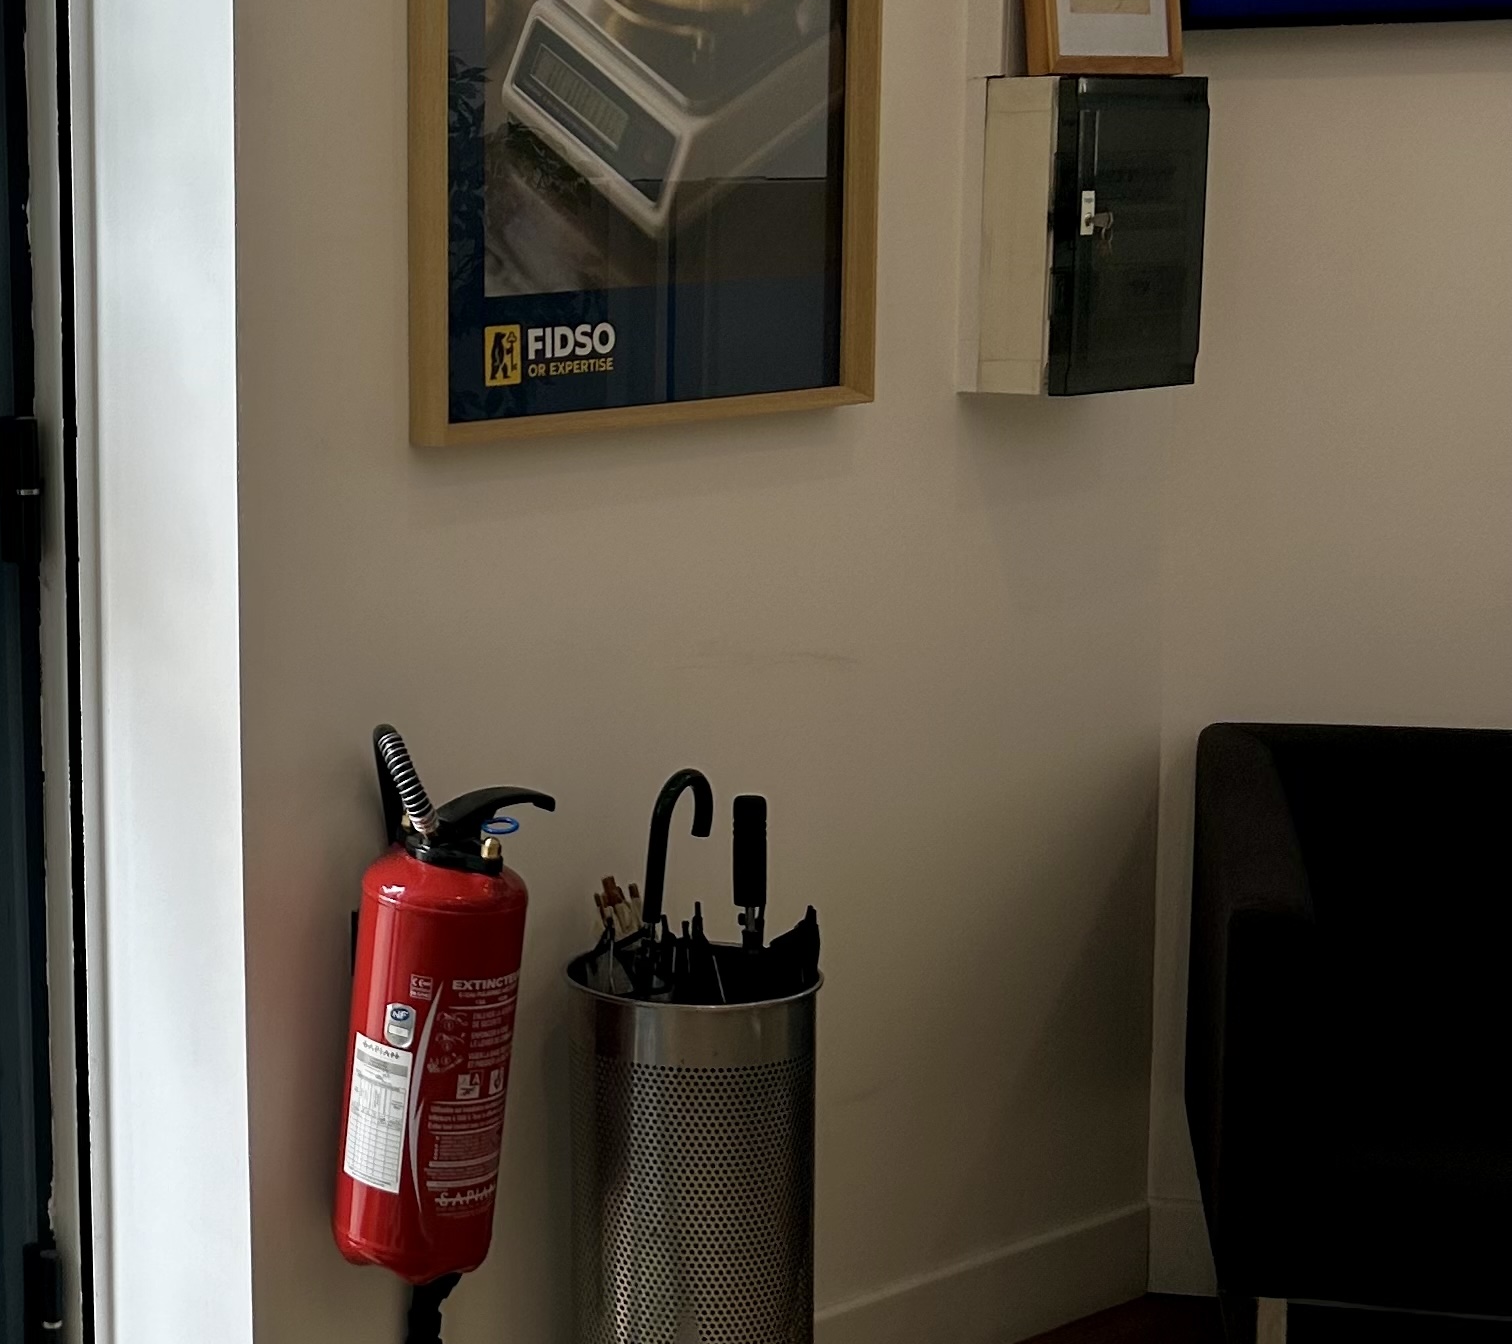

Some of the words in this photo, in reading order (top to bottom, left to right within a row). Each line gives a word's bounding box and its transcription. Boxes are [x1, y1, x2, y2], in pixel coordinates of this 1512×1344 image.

[527, 322, 616, 360] FIDSO
[528, 363, 546, 377] OR
[550, 358, 614, 376] EXPERTISE
